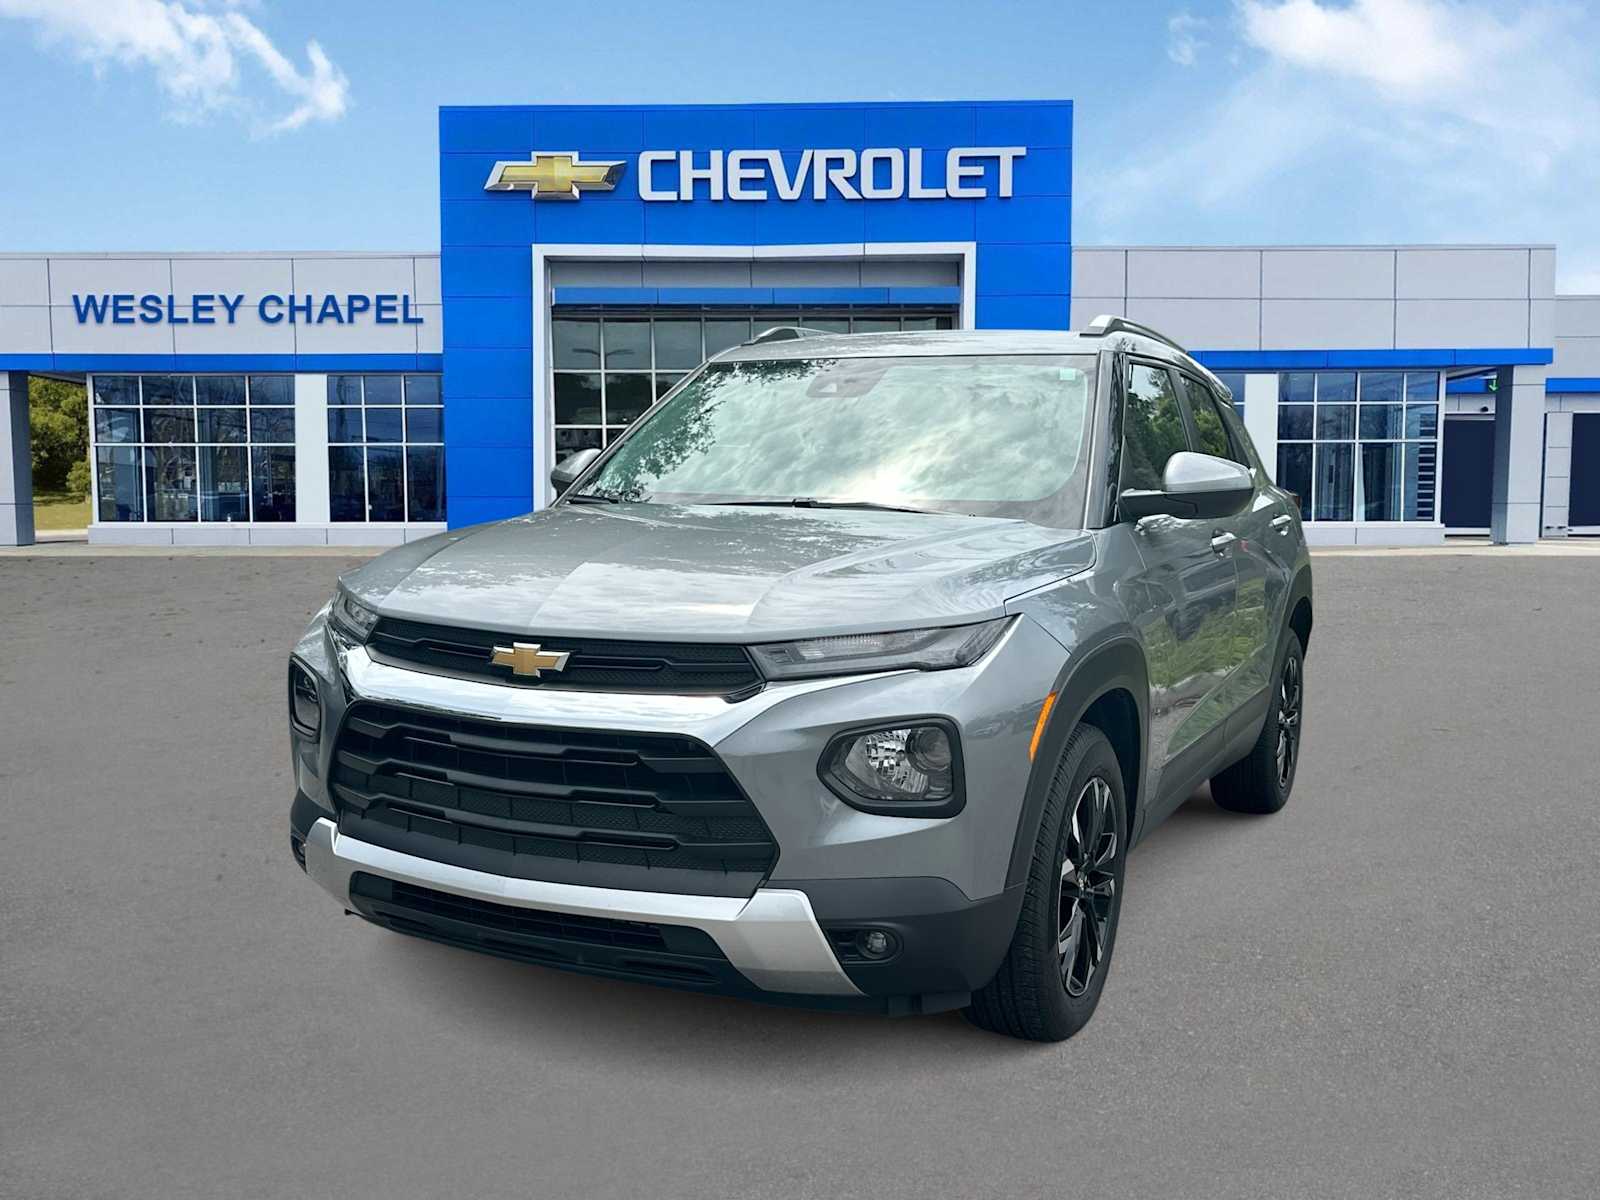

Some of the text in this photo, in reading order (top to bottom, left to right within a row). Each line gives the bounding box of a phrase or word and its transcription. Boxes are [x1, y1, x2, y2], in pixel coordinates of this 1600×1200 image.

[638, 146, 1027, 202] CHEVROLET
[72, 294, 424, 324] WESLEY CHAPEL
